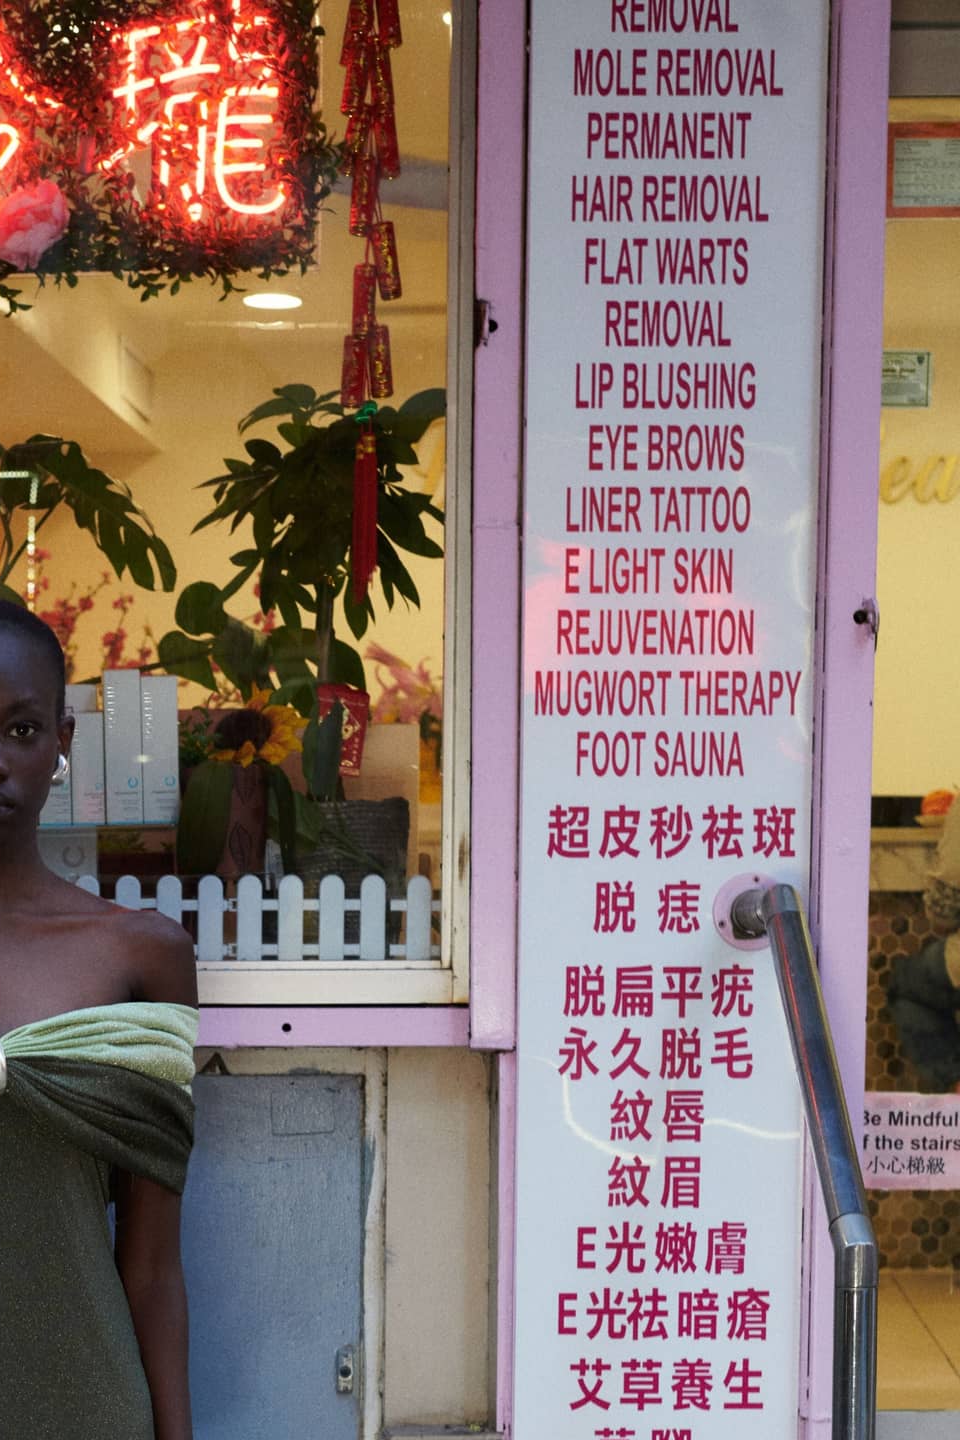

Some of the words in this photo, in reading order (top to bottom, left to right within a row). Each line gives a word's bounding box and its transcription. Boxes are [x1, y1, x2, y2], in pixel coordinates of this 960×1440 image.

[611, 0, 738, 33] REMOVAL
[573, 49, 647, 97] MOLE
[656, 49, 784, 96] REMOVAL
[587, 113, 752, 160] PERMANENT
[571, 175, 633, 223] HAIR
[642, 175, 769, 222] REMOVAL
[585, 238, 649, 285] FLAT
[656, 238, 749, 285] WARTS
[605, 301, 732, 347] REMOVAL
[575, 363, 614, 409] LIP
[623, 362, 756, 409] BLUSHING
[588, 425, 639, 471] EYE
[647, 424, 745, 471] BROWS
[565, 486, 642, 533] LINER
[649, 486, 751, 533] TATTOO
[564, 548, 581, 594] E
[589, 548, 666, 594] LIGHT
[673, 548, 734, 594] SKIN
[556, 609, 755, 656] REJUVENATION
[534, 670, 672, 717] MUGWORT
[679, 670, 802, 717] THERAPY
[576, 731, 647, 777] FOOT
[654, 731, 745, 777] SAUNA
[610, 1089, 705, 1143] 紋唇
[889, 1111, 958, 1127] Mindful
[866, 1155, 945, 1175] 小心梯級
[875, 1135, 904, 1151] the
[911, 1136, 960, 1152] stairs
[607, 1156, 701, 1209] 紋眉
[569, 1358, 764, 1411] 艾草養生
